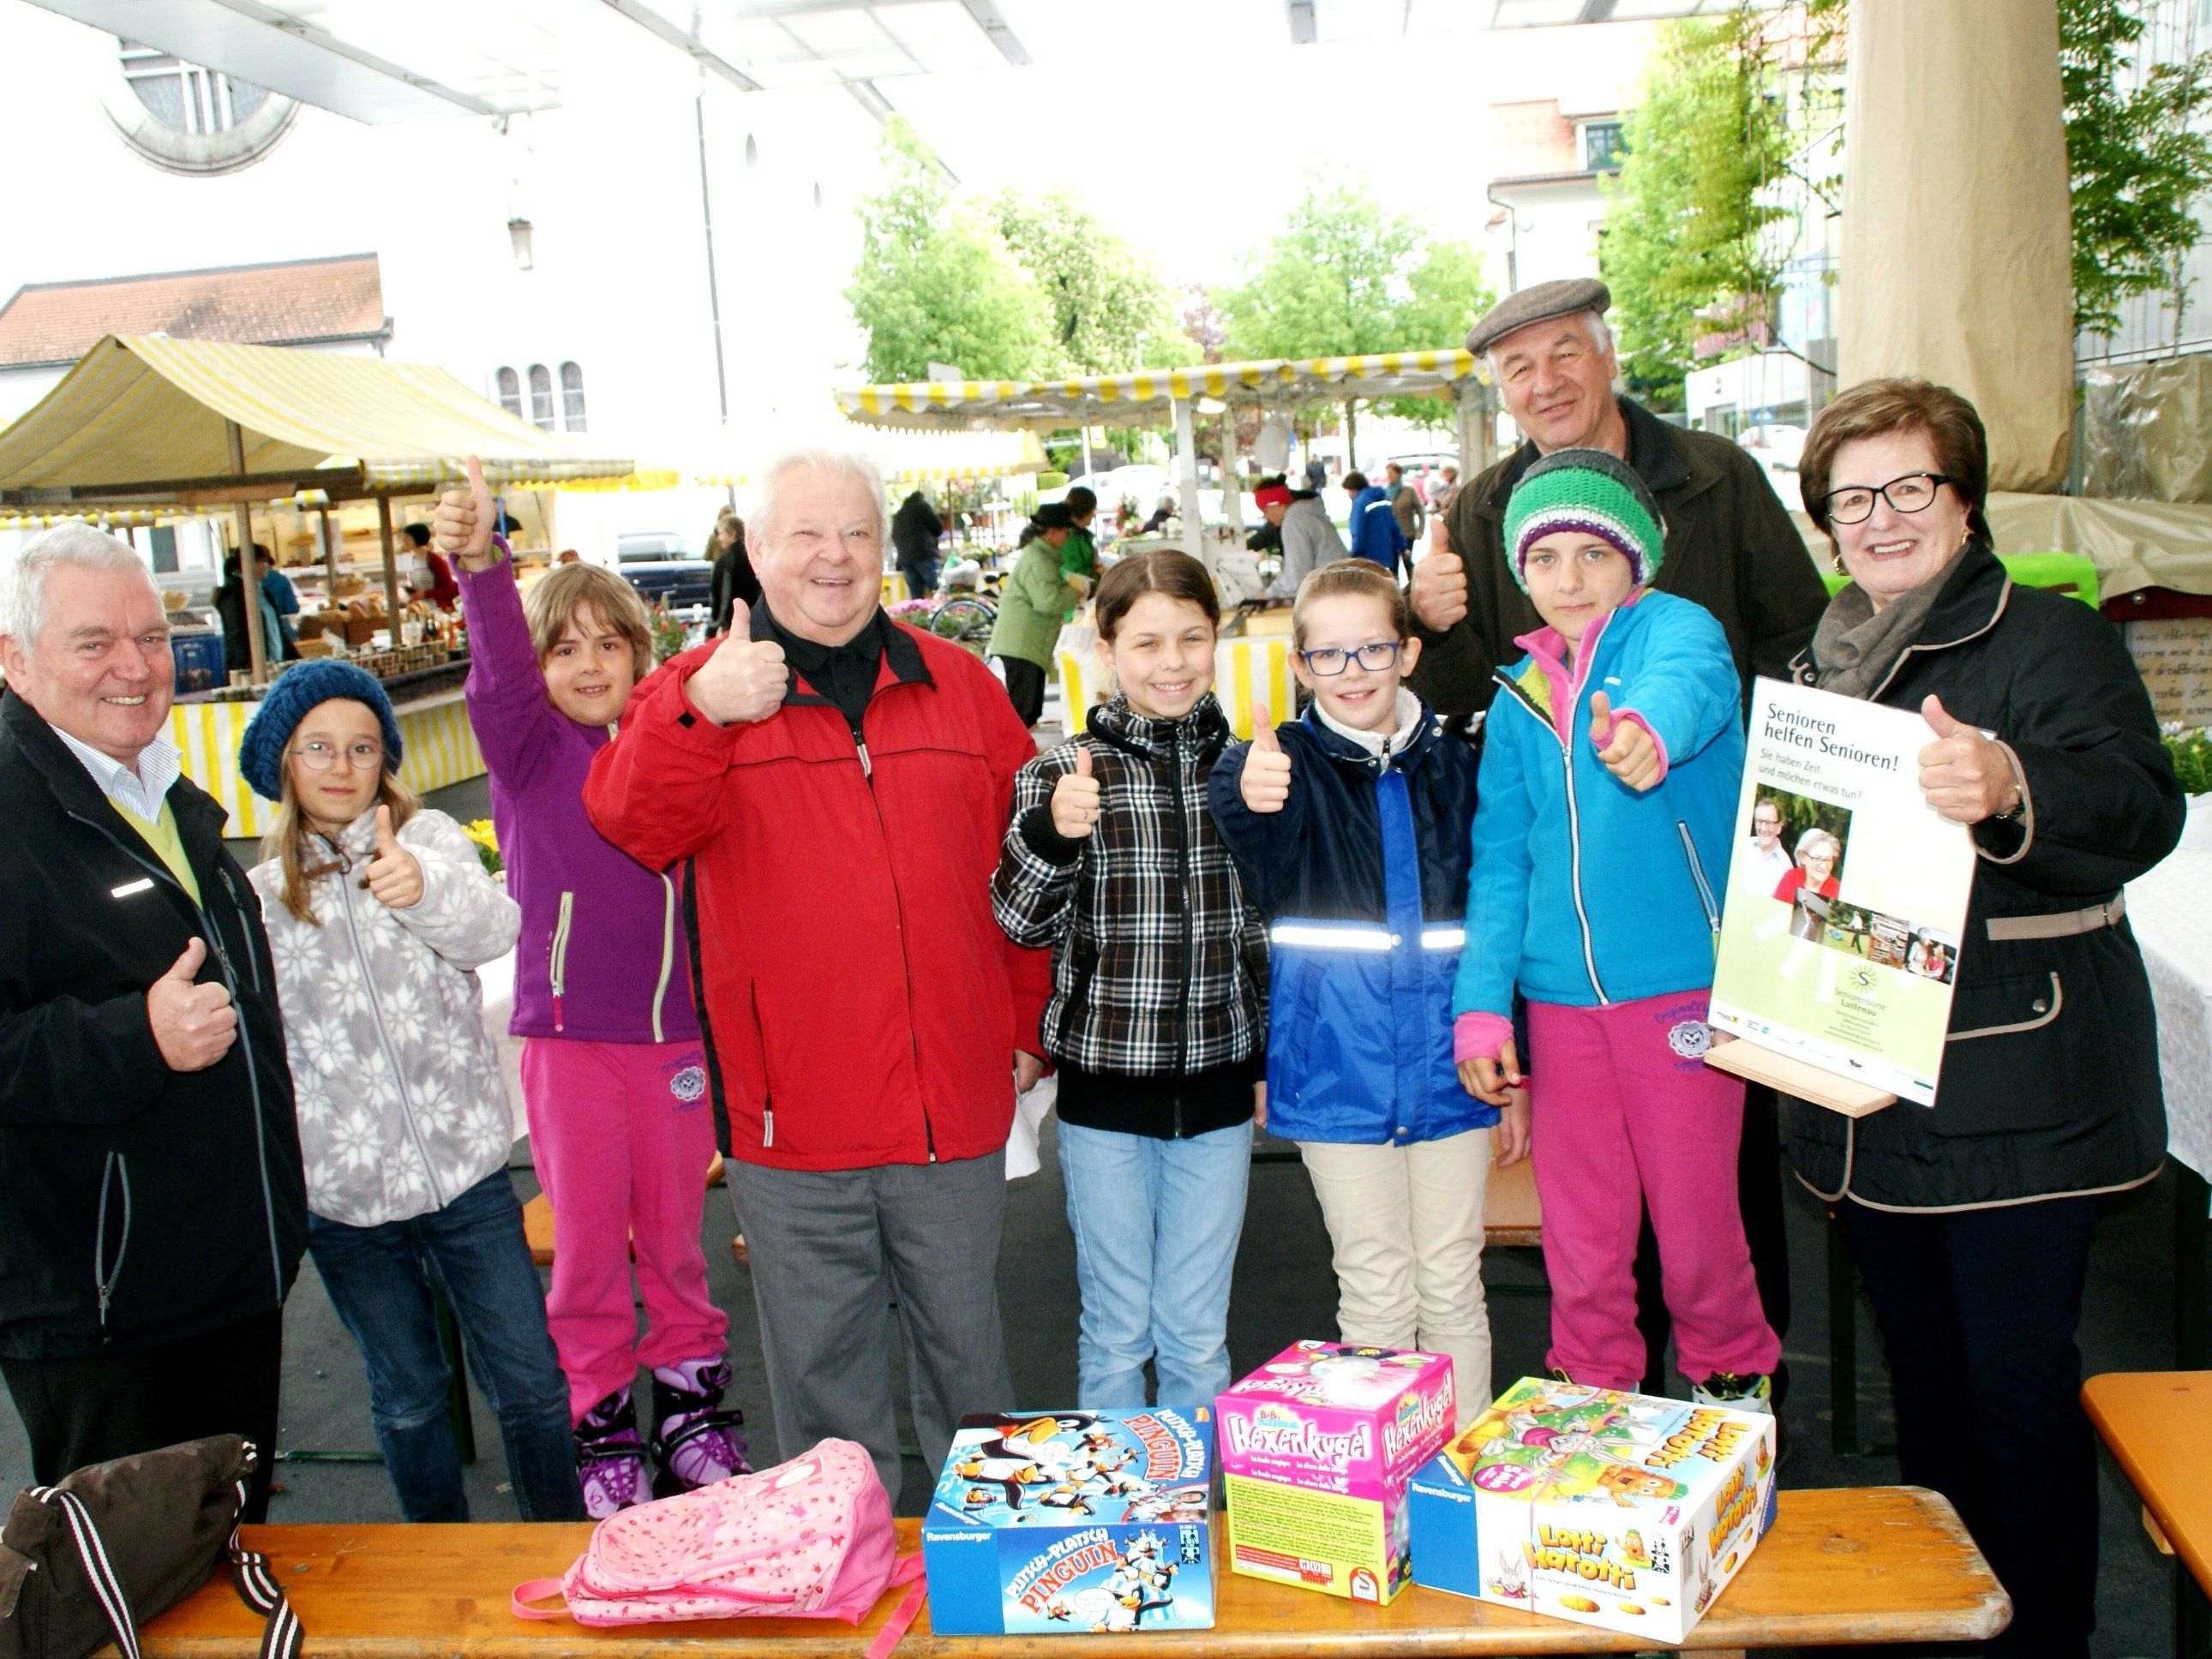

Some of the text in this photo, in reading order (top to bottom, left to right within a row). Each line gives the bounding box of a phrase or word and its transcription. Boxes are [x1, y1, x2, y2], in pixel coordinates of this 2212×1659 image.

[1767, 703, 1836, 735] Senioren
[1760, 748, 1821, 774] Sie haben Zeit
[1765, 722, 1899, 772] helfen Senioren!
[1759, 764, 1776, 776] und
[1813, 779, 1839, 795] etwas
[1841, 787, 1862, 800] tun?
[1119, 1413, 1182, 1482] PINGUIN
[1227, 1415, 1370, 1466] Hexenkugel
[1412, 1482, 1472, 1503] Ravensburger
[926, 1530, 992, 1542] Ravensburger
[1538, 1524, 1608, 1558] Lotti
[1018, 1539, 1119, 1615] PINGUIN
